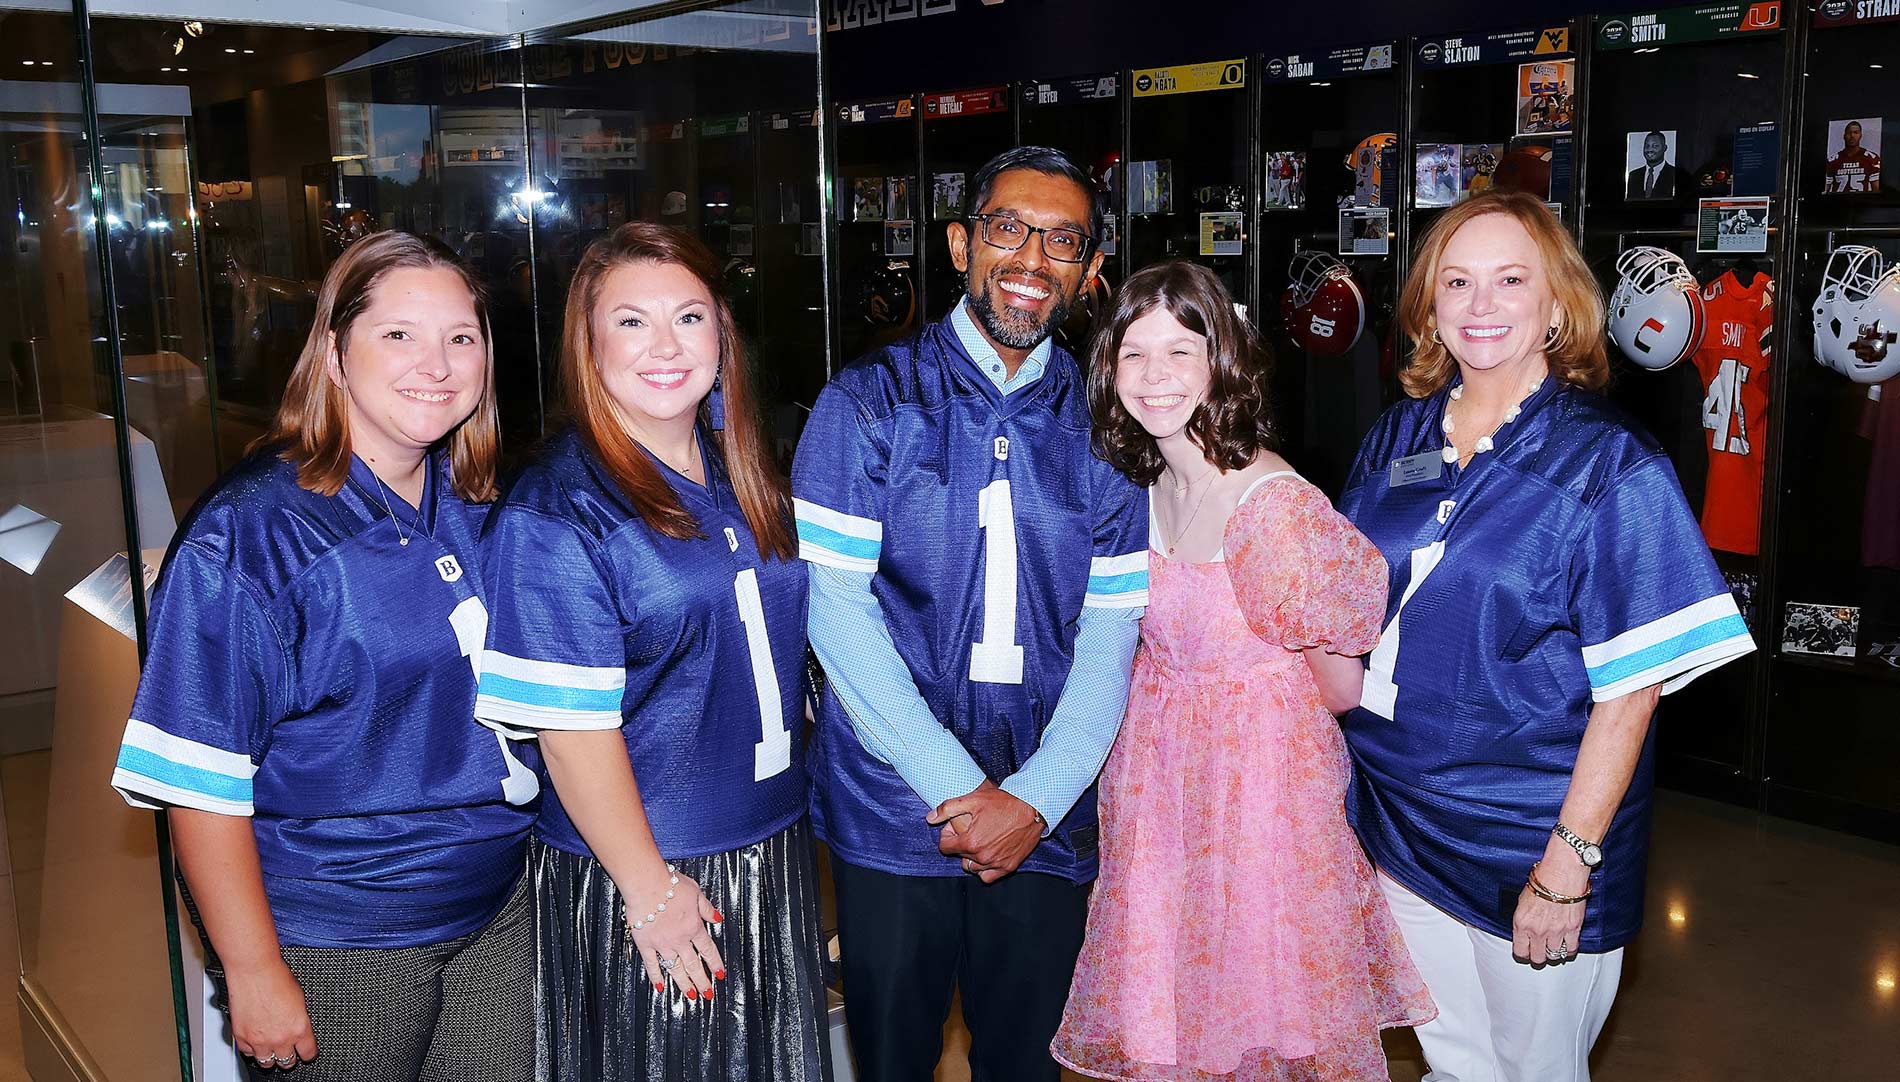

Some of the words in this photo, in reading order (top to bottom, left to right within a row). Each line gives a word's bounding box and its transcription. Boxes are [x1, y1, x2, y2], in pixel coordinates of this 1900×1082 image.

[1631, 14, 1657, 27] DARRIN
[1631, 24, 1666, 43] SMITH
[1444, 38, 1462, 49] STEVE
[1444, 46, 1480, 64] SLATON
[1287, 62, 1313, 78] SABAN
[1835, 174, 1866, 192] 75
[1310, 314, 1336, 338] 18
[1702, 358, 1750, 456] 45
[439, 560, 457, 577] B
[969, 479, 1024, 685] 1
[734, 567, 791, 783] 1
